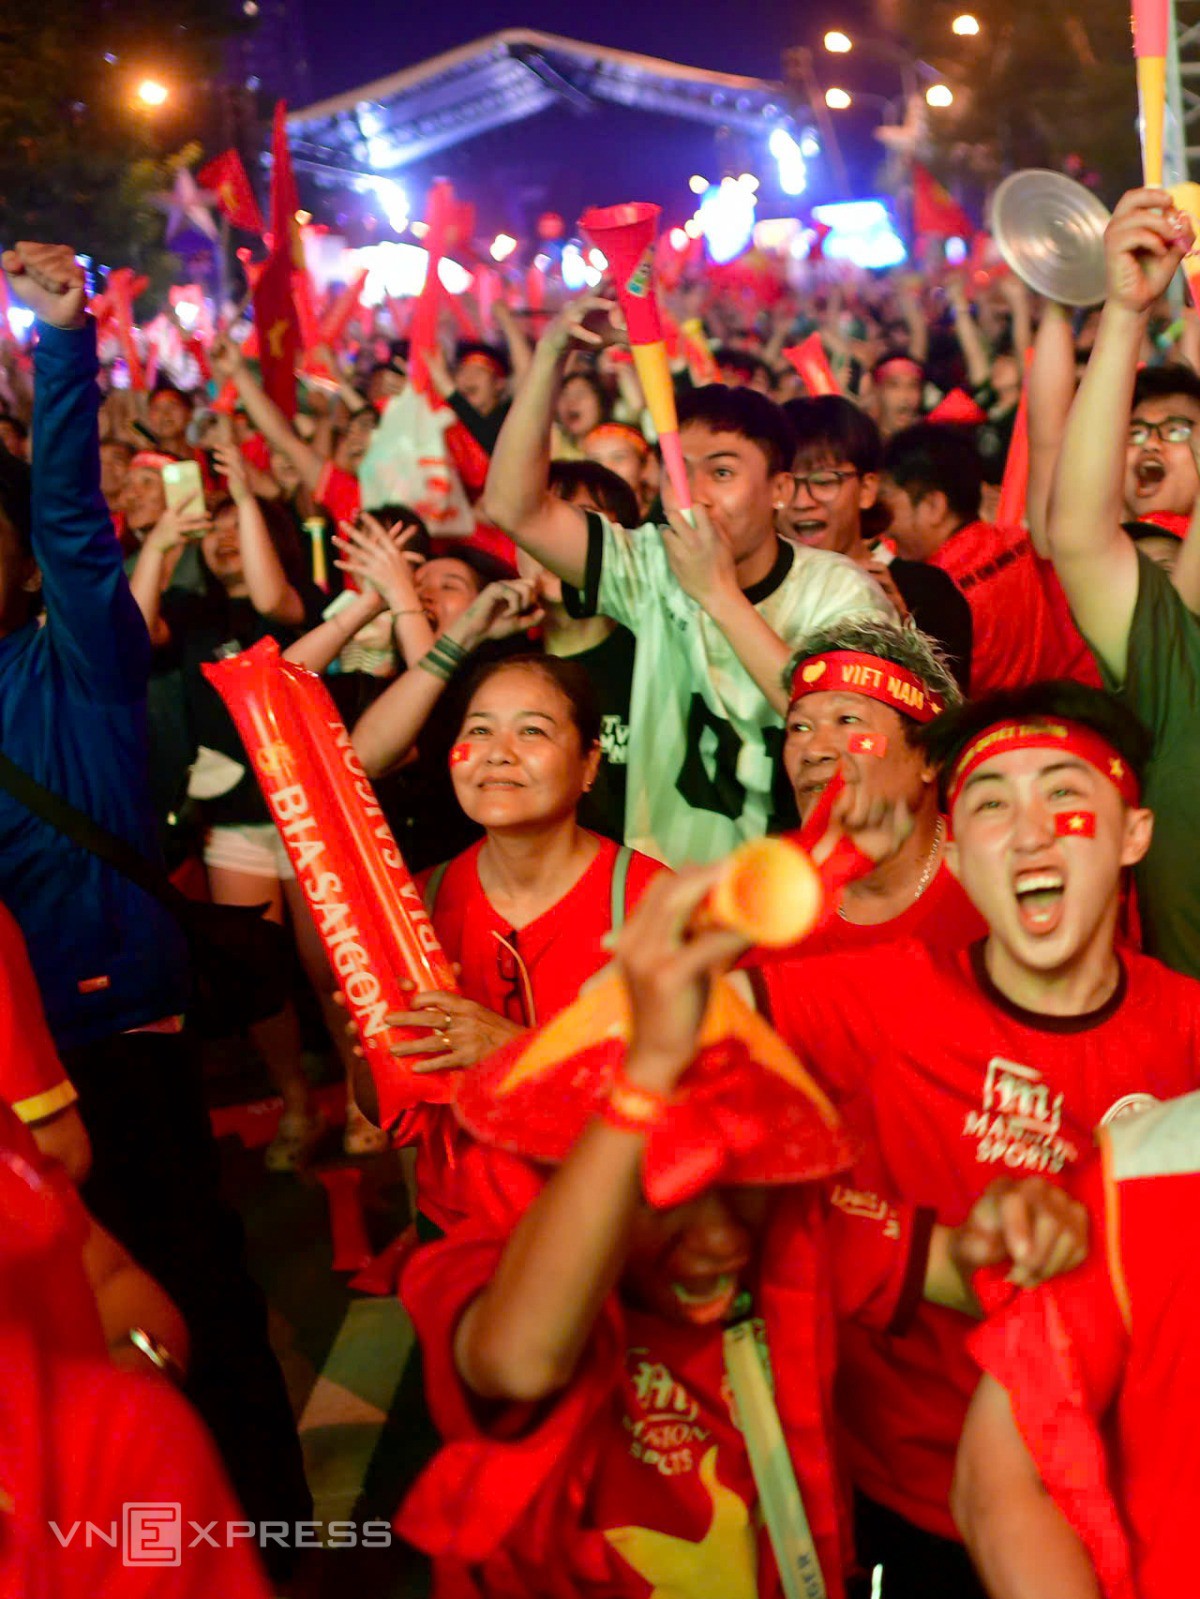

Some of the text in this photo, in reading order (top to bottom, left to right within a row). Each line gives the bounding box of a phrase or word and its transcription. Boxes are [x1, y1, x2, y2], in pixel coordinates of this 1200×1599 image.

[887, 675, 924, 710] NAM
[270, 784, 391, 1038] BIA SAIGON
